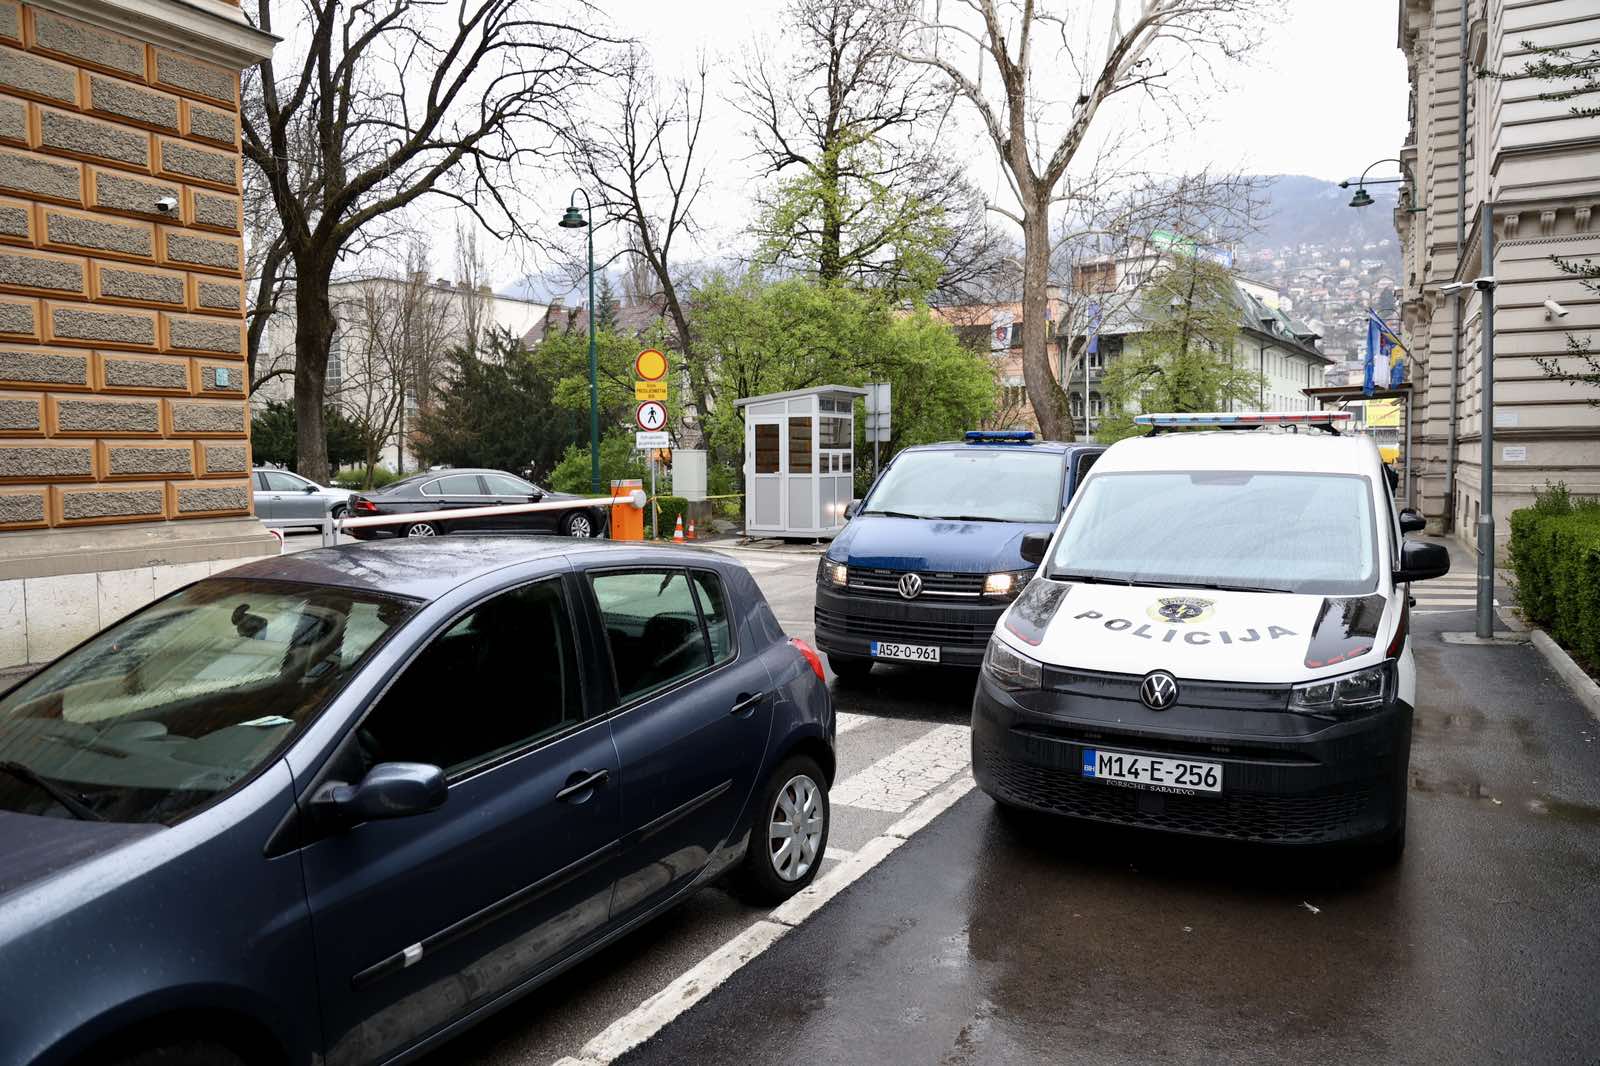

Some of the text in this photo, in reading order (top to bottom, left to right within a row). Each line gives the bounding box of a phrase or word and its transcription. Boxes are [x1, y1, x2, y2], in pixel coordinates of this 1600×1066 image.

[1073, 610, 1299, 645] POLICIJA
[1099, 754, 1218, 788] M14-E-256
[1106, 779, 1195, 796] PORSCHE SARAJEVO
